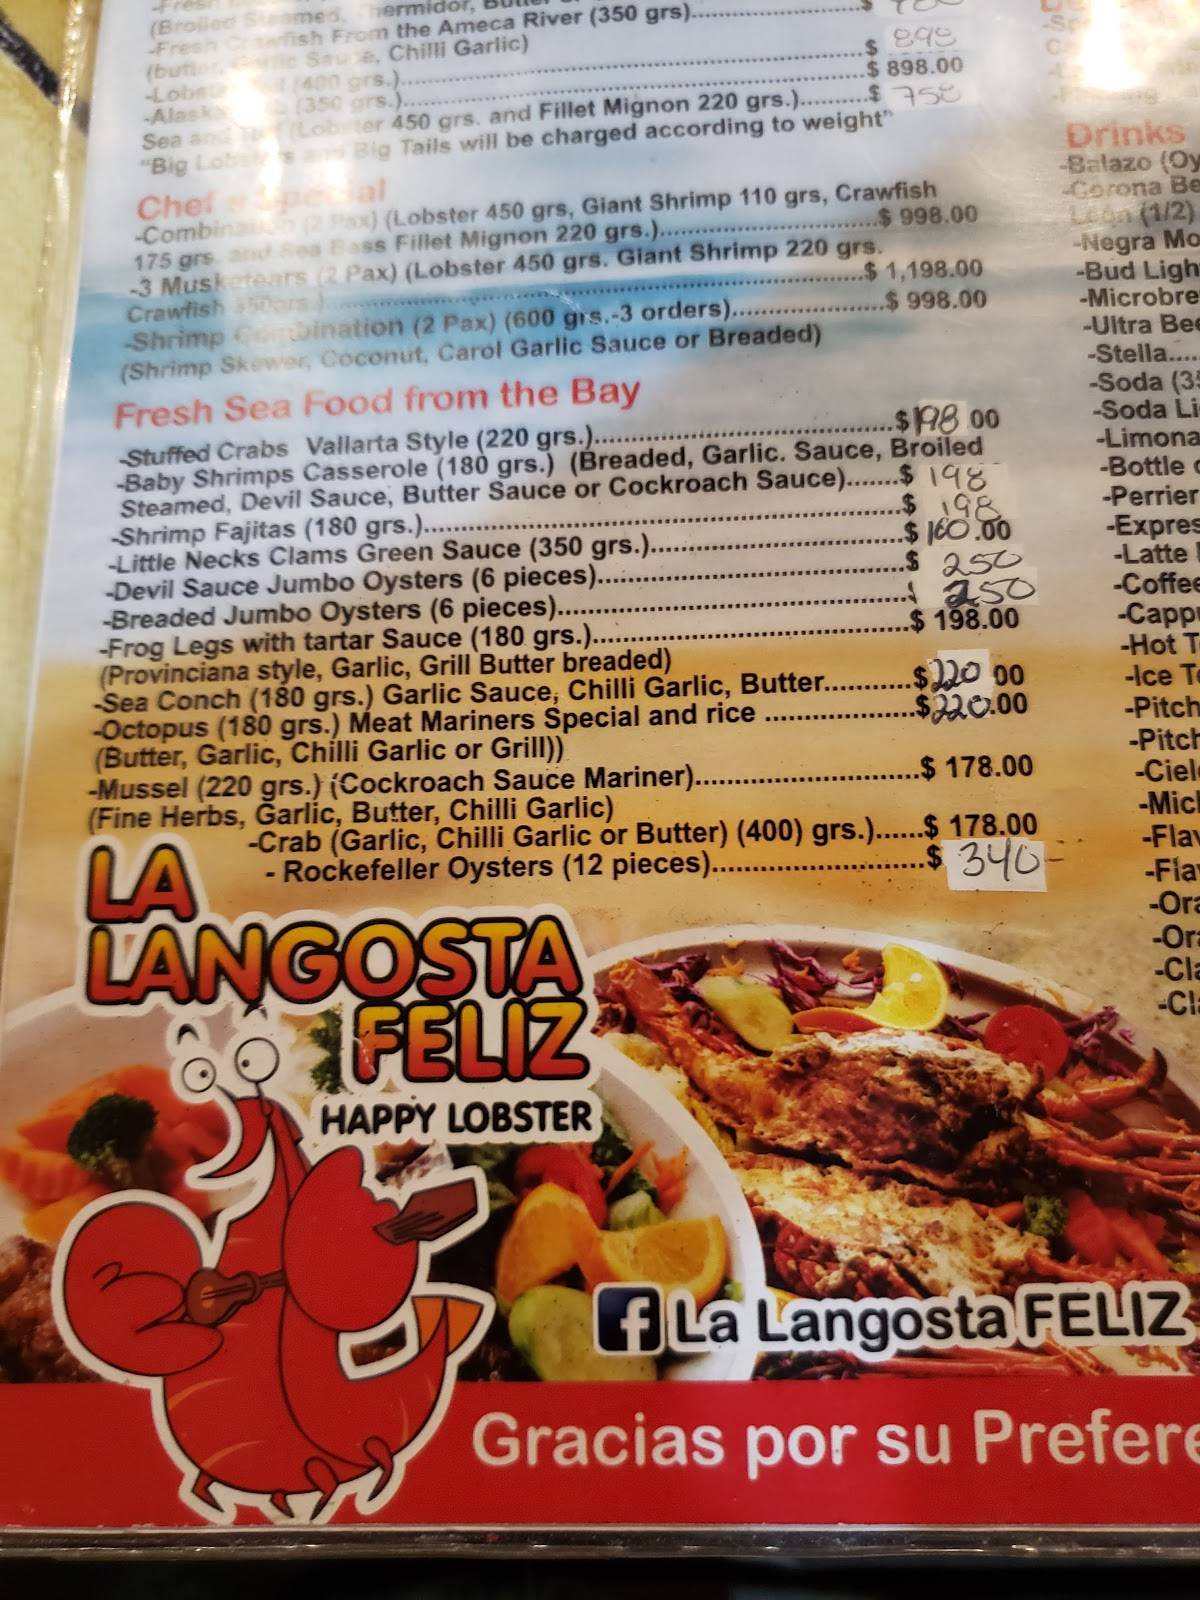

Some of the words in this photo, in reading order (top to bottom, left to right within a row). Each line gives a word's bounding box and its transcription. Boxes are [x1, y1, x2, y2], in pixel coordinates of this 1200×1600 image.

[396, 23, 431, 39] the
[438, 17, 515, 36] Ameca
[524, 11, 583, 28] River
[887, 57, 963, 77] 898.00
[392, 114, 431, 130] 450
[439, 113, 480, 133] grs.
[490, 107, 531, 124] and
[539, 102, 595, 120] Fillet
[604, 98, 689, 118] Mignon
[699, 94, 738, 111] 220
[401, 138, 451, 155] Tails
[460, 134, 498, 151] will
[507, 132, 533, 148] be
[542, 124, 635, 147] charged
[645, 120, 764, 139] according
[773, 117, 795, 132] to
[1066, 120, 1186, 148] Drinks
[486, 202, 524, 220] 450
[532, 202, 574, 222] grs,
[582, 195, 642, 215] Giant
[650, 191, 731, 211] Shrimp
[740, 187, 777, 205] 110
[785, 189, 827, 208] grs,
[835, 181, 936, 202] Crawfish
[1141, 200, 1194, 227] (1/2)
[134, 254, 172, 271] 175
[395, 232, 452, 252] Fillet
[460, 229, 547, 251] Mignon
[556, 222, 597, 242] 220
[900, 204, 978, 225] 998.00
[513, 253, 553, 271] 450
[563, 252, 607, 273] grs.
[617, 246, 681, 266] Giant
[690, 241, 777, 262] Shrimp
[786, 238, 827, 257] 220
[836, 240, 882, 259] grs.
[127, 300, 224, 323] Crawfish
[886, 259, 983, 282] 1,198.00
[907, 289, 986, 310] 998.00
[320, 347, 429, 367] Coconut,
[511, 335, 582, 358] Garlic
[591, 332, 667, 354] Sauce
[678, 332, 698, 348] or
[709, 323, 821, 347] Breaded)
[115, 399, 212, 429] Fresh
[224, 395, 291, 422] Sea
[304, 390, 392, 417] Food
[405, 387, 487, 411] from
[501, 381, 558, 407] the
[572, 378, 640, 406] Bay
[194, 467, 294, 489] Shrimps
[303, 460, 428, 482] Casserole
[570, 446, 693, 477] (Breaded,
[794, 440, 881, 462] Sauce,
[891, 436, 983, 458] Broiled
[217, 440, 288, 461] Crabs
[306, 435, 398, 456] Vallarta
[406, 431, 469, 454] Style
[120, 496, 231, 518] Steamed,
[241, 490, 301, 511] Devil
[310, 488, 393, 508] Sauce,
[403, 484, 480, 504] Butter
[489, 481, 566, 501] Sauce
[574, 482, 601, 498] or
[609, 472, 747, 496] Cockroach
[215, 521, 295, 545] Fajitas
[185, 549, 260, 570] Necks
[269, 546, 347, 566] Clams
[357, 542, 433, 563] Green
[443, 539, 521, 560] Sauce
[182, 578, 259, 598] Sauce
[267, 573, 354, 594] Jumbo
[363, 571, 462, 592] Oysters
[173, 636, 234, 656] Legs
[243, 631, 294, 652] with
[304, 631, 374, 650] tartar
[382, 628, 462, 649] Sauce
[934, 607, 1019, 630] 198.00
[224, 604, 311, 624] Jumbo
[320, 601, 421, 622] Oysters
[99, 662, 249, 689] (Provinciana
[257, 658, 323, 683] style,
[331, 656, 411, 680] Garlic,
[420, 654, 470, 675] Grill
[480, 654, 553, 675] Butter
[563, 648, 671, 674] breaded)
[157, 689, 240, 710] Conch
[383, 683, 461, 704] Garlic
[470, 681, 558, 705] Sauce,
[569, 677, 637, 700] Chilli
[648, 675, 731, 699] Garlic,
[350, 711, 412, 733] Meat
[421, 709, 535, 731] Mariners
[544, 705, 640, 732] Special
[650, 704, 697, 726] and
[707, 702, 755, 724] rice
[95, 746, 187, 771] (Butter,
[198, 744, 281, 767] Garlic,
[291, 740, 358, 763] Chilli
[368, 739, 446, 761] Garlic
[455, 743, 482, 759] or
[330, 770, 484, 800] (Cockroach
[494, 769, 575, 791] Sauce
[946, 754, 1033, 778] 178.00
[161, 804, 245, 830] Herbs,
[255, 802, 342, 826] Garlic,
[352, 801, 439, 824] Butter,
[450, 797, 517, 821] Chilli
[331, 827, 426, 854] (Garlic,
[437, 826, 503, 849] Chilli
[513, 822, 593, 847] Garlic
[601, 823, 627, 845] or
[949, 813, 1037, 838] 178.00
[86, 843, 198, 923] LA
[283, 858, 441, 883] Rockefeller
[447, 855, 554, 881] Oysters
[86, 914, 584, 1005] LANGOSTA
[352, 997, 591, 1085] FELIZ
[320, 1101, 435, 1135] HAPPY
[448, 1099, 592, 1134] LOBSTER
[674, 1297, 740, 1344] La
[756, 1294, 1008, 1353] Langosta
[1024, 1288, 1188, 1338] FELIZ
[472, 1411, 725, 1467] Gracias
[746, 1420, 857, 1481] por
[877, 1423, 951, 1467] su
